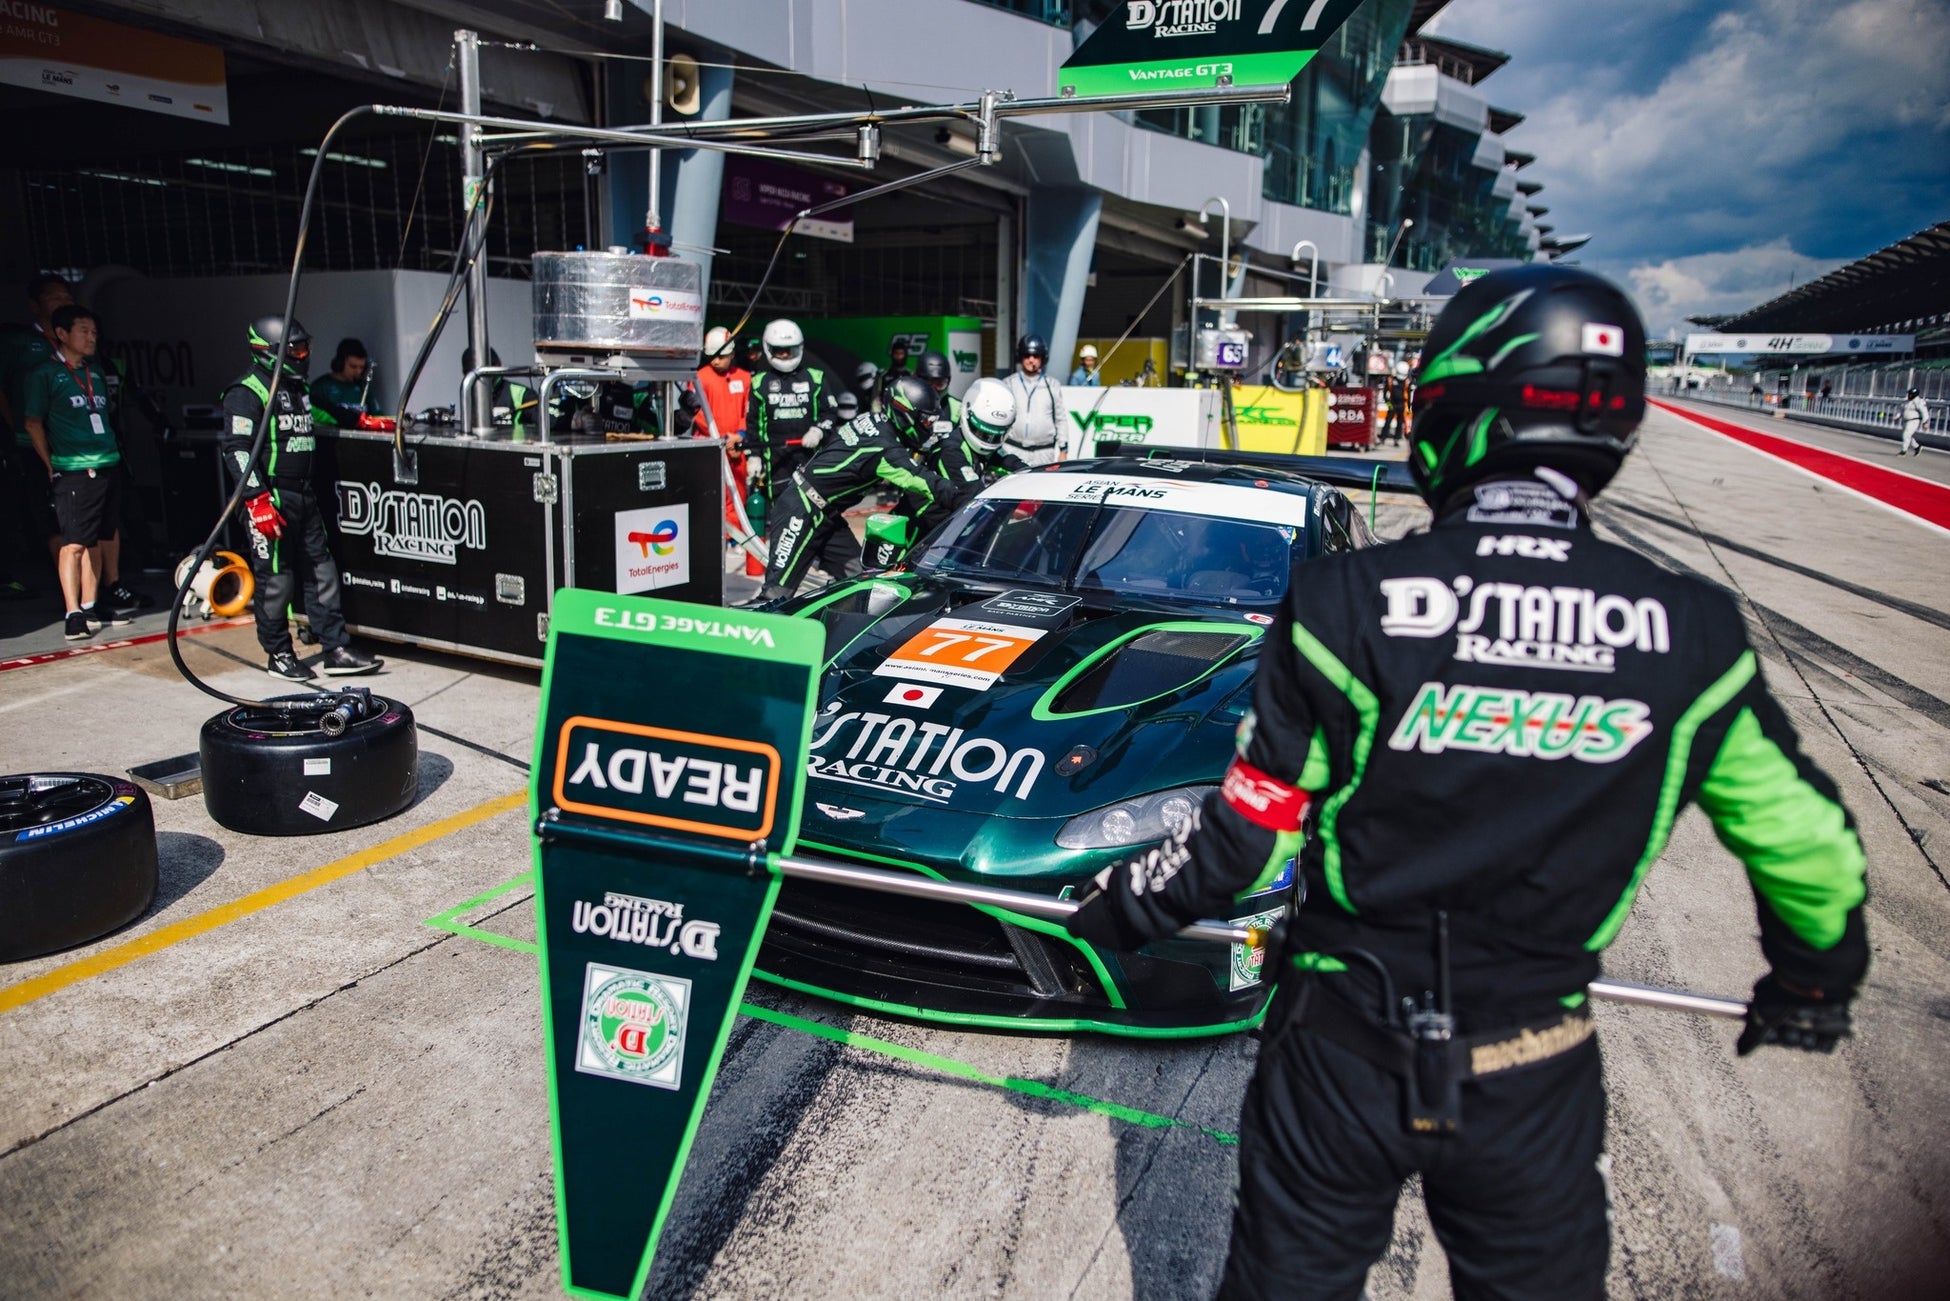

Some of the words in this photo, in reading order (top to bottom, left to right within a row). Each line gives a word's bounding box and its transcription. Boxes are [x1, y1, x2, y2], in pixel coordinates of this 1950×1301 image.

[1127, 0, 1242, 28] D'STATION
[6, 26, 36, 41] AMR
[38, 31, 61, 47] GT3
[1154, 22, 1216, 38] RACING
[1128, 67, 1193, 81] VANTAGE
[1196, 63, 1233, 77] GT3
[1222, 345, 1244, 364] 65
[1070, 410, 1153, 433] VIPER
[1074, 485, 1101, 493] LE
[1104, 485, 1167, 498] MANS
[335, 480, 486, 549] D'STATION
[374, 533, 456, 562] RACING
[629, 562, 679, 577] TotalEnergies
[594, 607, 657, 631] GT3
[1380, 575, 1670, 653] D'STATION
[662, 615, 775, 648] VANTAGE
[919, 632, 1015, 662] 77
[1453, 634, 1616, 670] RACING
[885, 663, 991, 682] www.asianlmansseries.com
[1390, 683, 1652, 762] NEXUS
[808, 701, 1046, 800] 'STATION
[568, 743, 763, 813] READY
[806, 754, 957, 798] RACING
[28, 806, 116, 837] MICHELIN
[604, 892, 684, 919] RACING
[572, 901, 721, 961] D'STATION
[605, 997, 663, 1023] STATION
